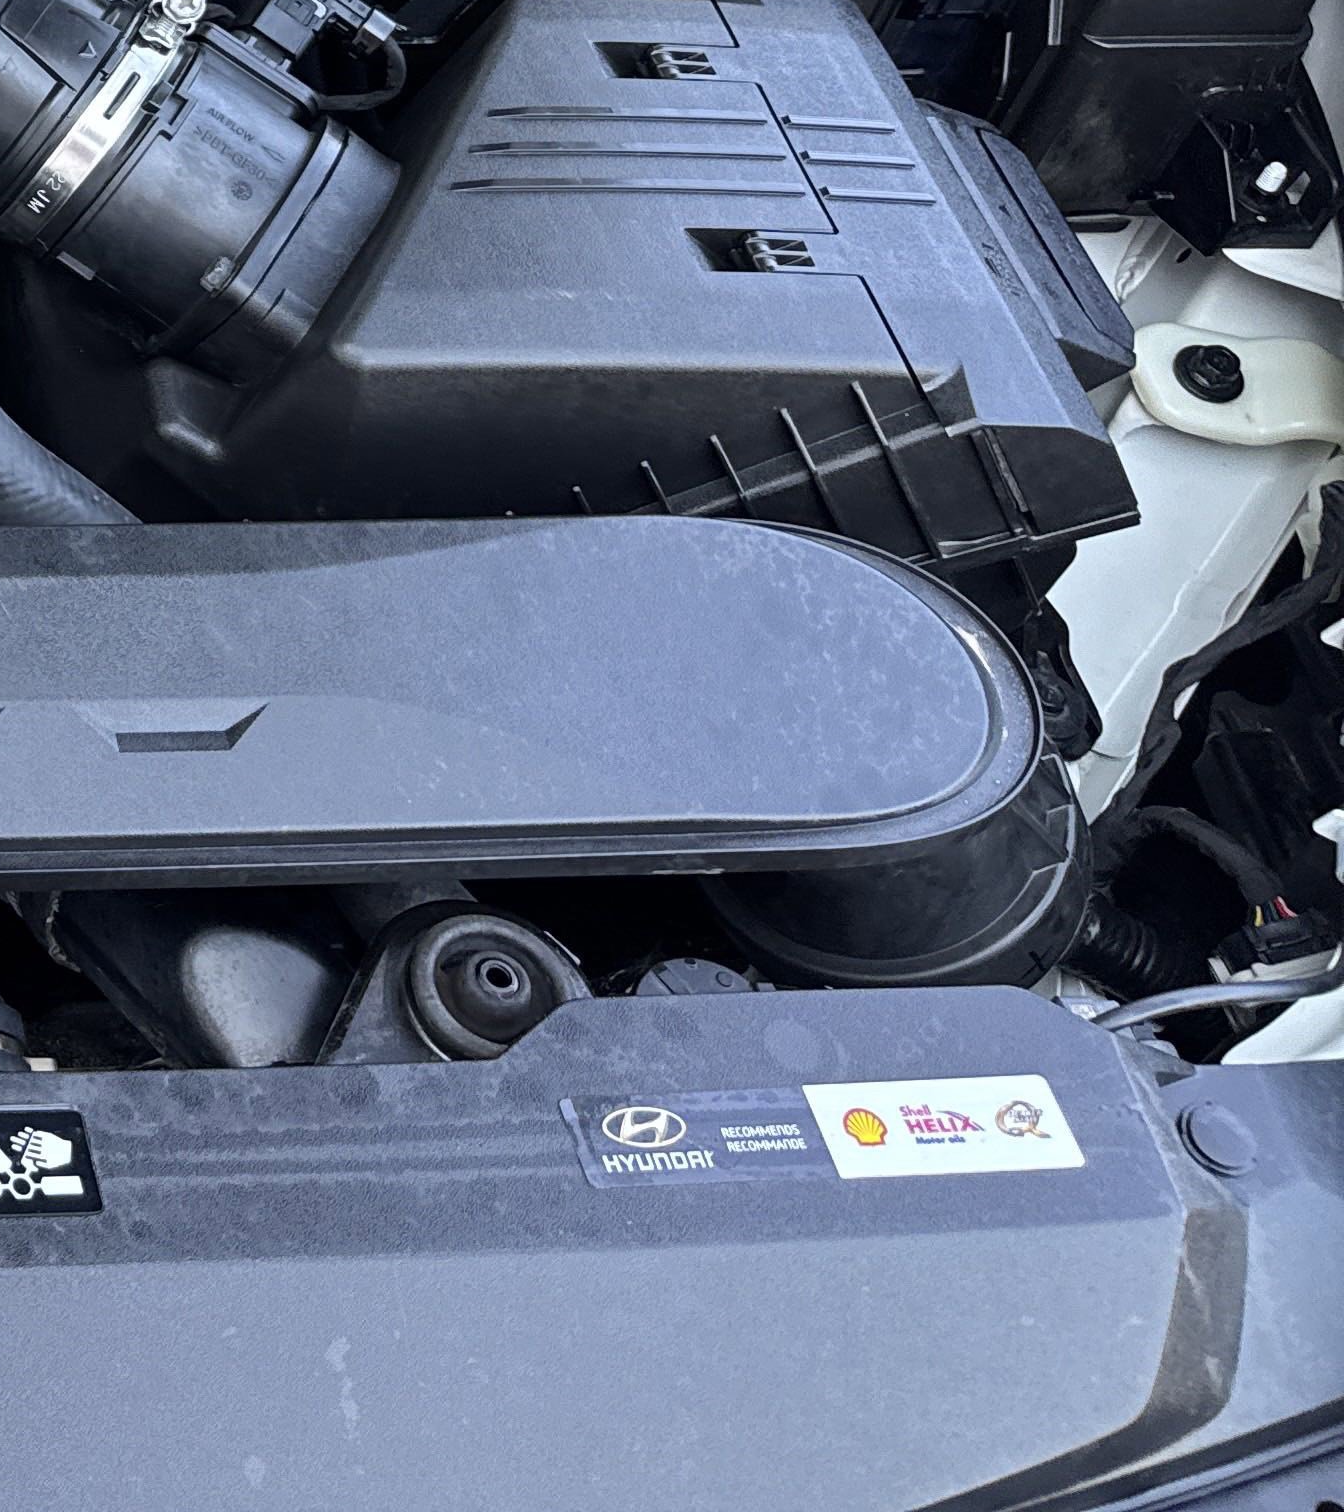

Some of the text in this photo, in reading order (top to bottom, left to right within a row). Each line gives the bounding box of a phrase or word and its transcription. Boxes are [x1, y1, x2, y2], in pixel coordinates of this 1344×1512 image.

[26, 187, 54, 216] JM
[899, 1104, 932, 1117] Shell
[720, 1123, 801, 1140] RECOMMENDS
[904, 1117, 980, 1135] HELIX
[726, 1138, 808, 1153] RECOMMANDE
[601, 1150, 715, 1174] HYUNDAI
